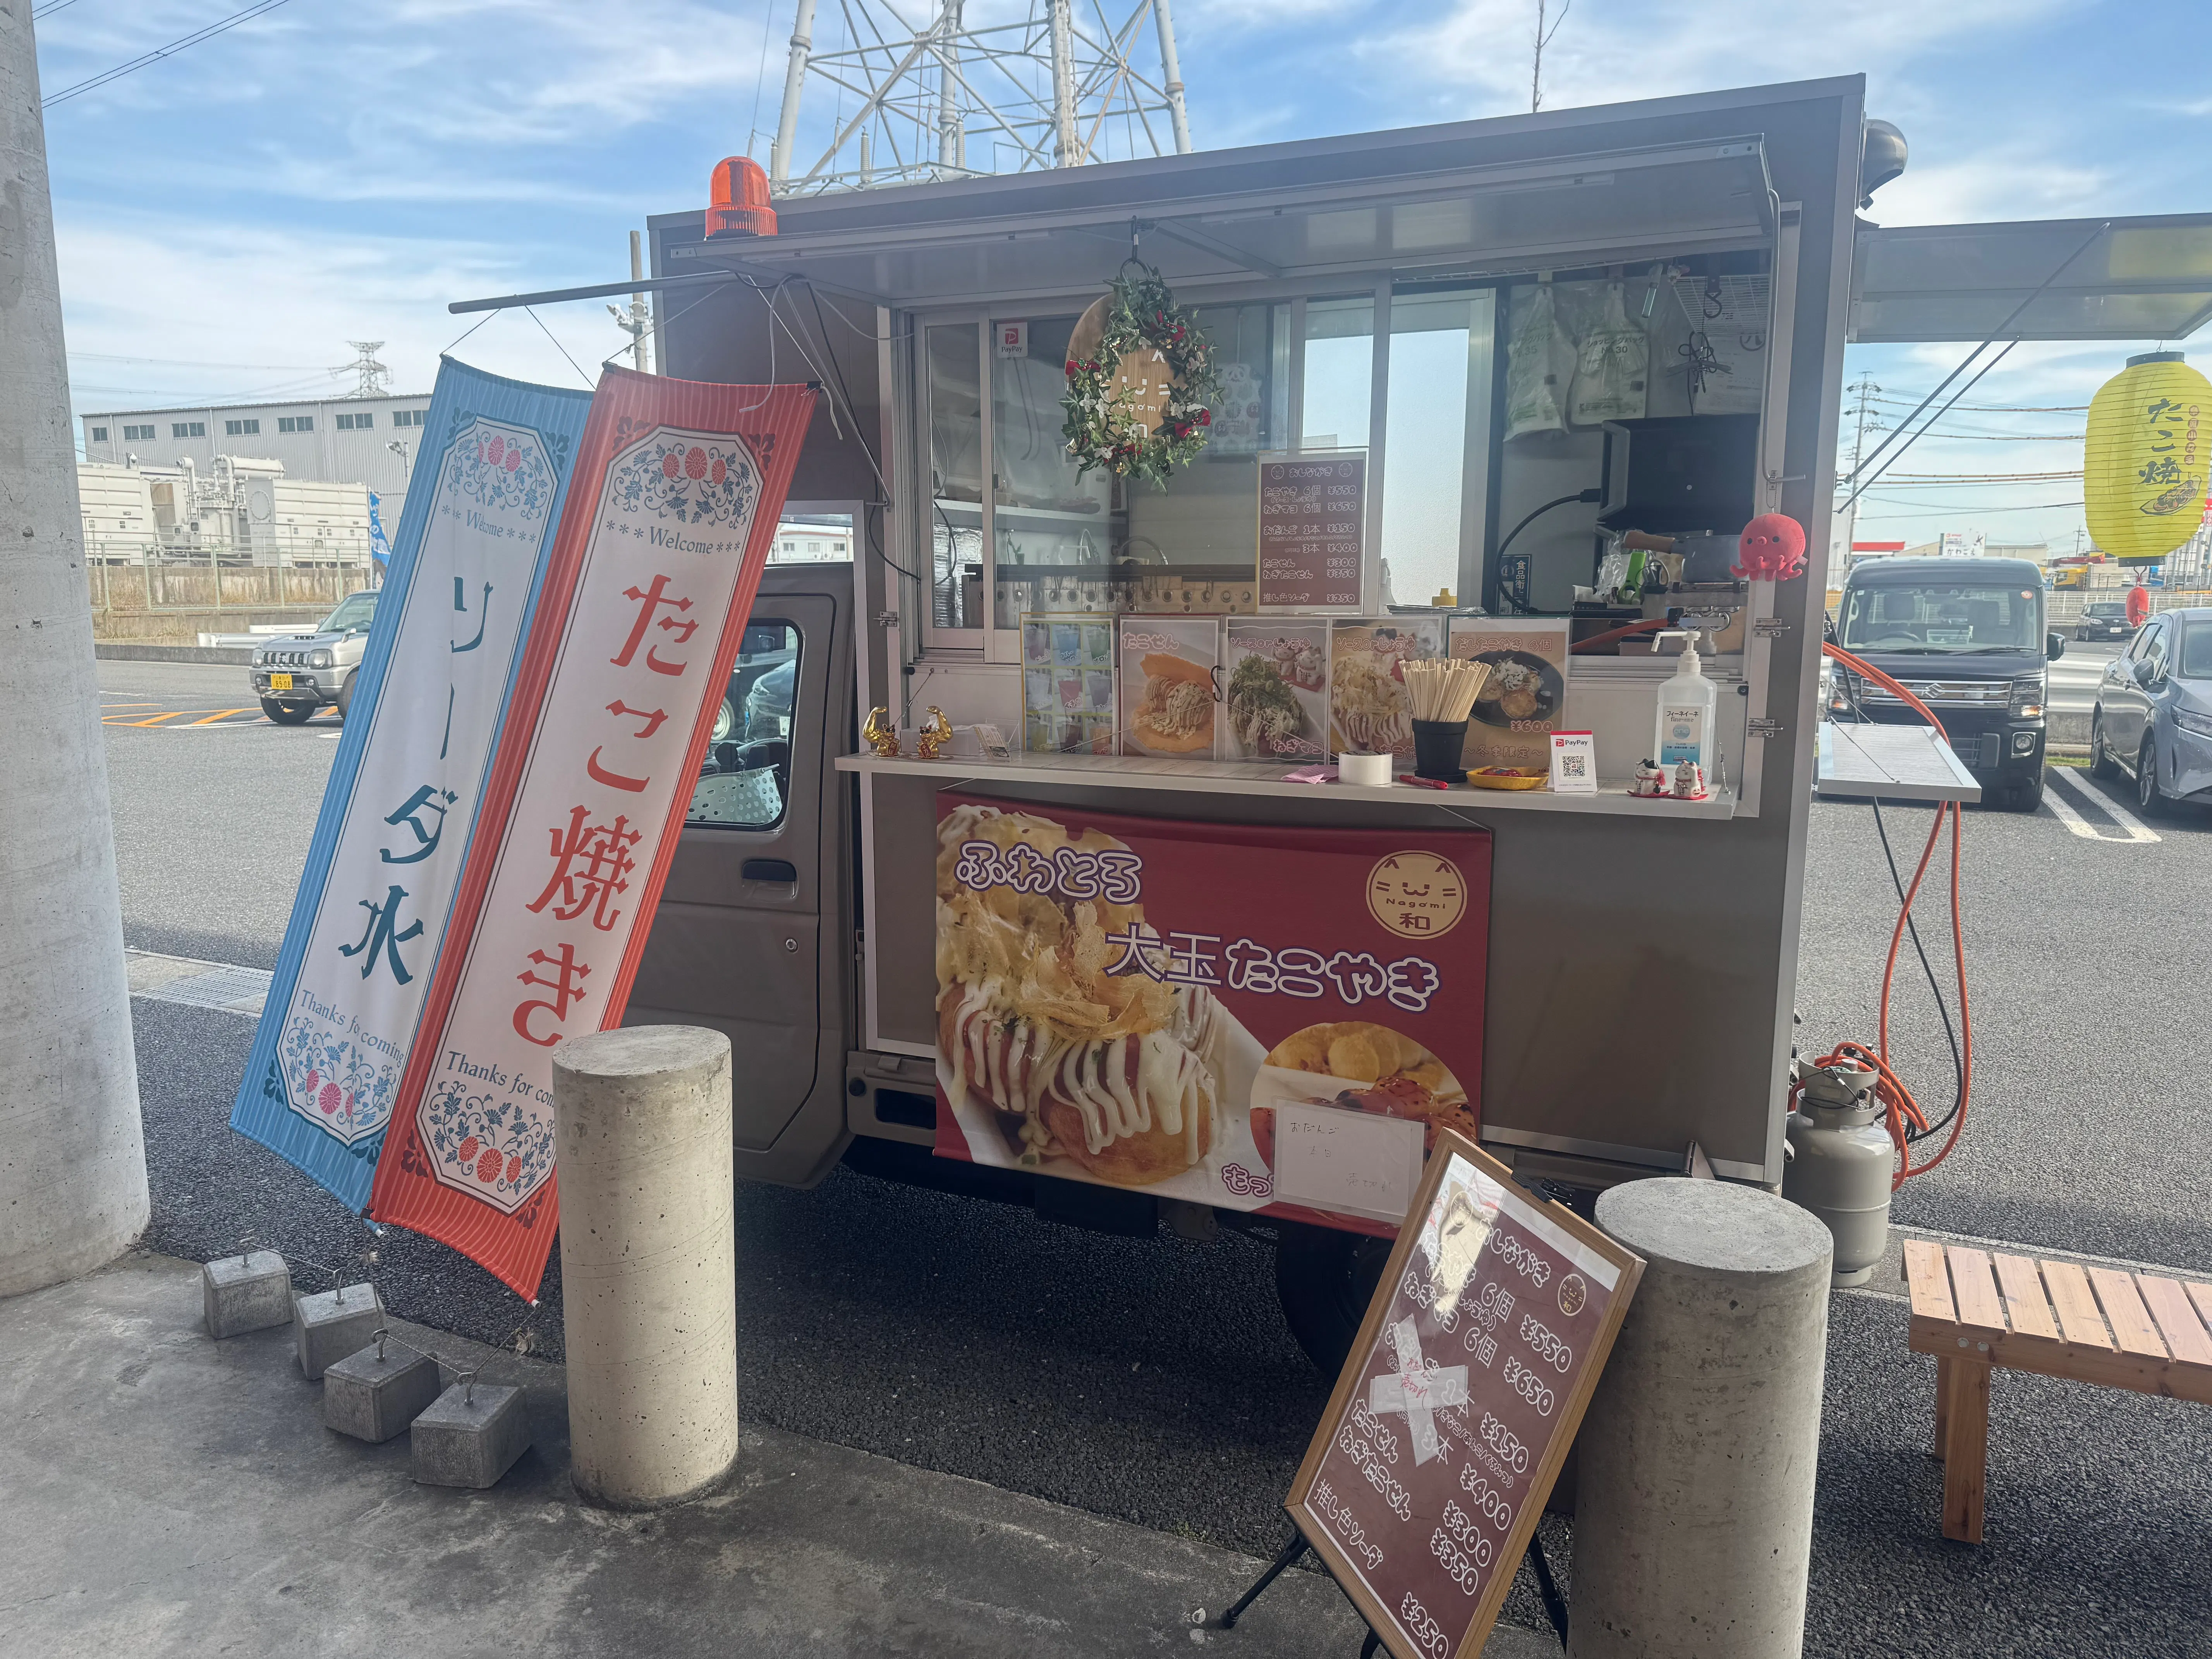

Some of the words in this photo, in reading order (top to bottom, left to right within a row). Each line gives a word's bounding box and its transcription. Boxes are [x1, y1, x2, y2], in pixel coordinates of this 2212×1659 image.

[1001, 346, 1023, 354] PayPay
[1113, 403, 1161, 412] agomi
[2138, 398, 2185, 486] たこ焼
[1289, 467, 1333, 477] おしながき
[1264, 486, 1297, 497] たこやき
[1304, 485, 1321, 496] 6個
[1328, 485, 1356, 495] ¥550
[1263, 504, 1298, 514] ねぎマヨ
[1303, 503, 1321, 514] 6個
[1328, 501, 1356, 511] ¥650
[1263, 525, 1297, 535] おだんご
[1303, 524, 1321, 535] 1本
[1327, 523, 1355, 533] ¥150
[650, 526, 713, 555] Welcome
[1302, 543, 1320, 553] 3本
[1327, 543, 1358, 553] ¥400
[1263, 558, 1295, 568] たこせん
[1327, 558, 1356, 567] ¥300
[1262, 570, 1313, 579] ねぎたこせん
[1327, 569, 1356, 578] ¥350
[1263, 592, 1310, 603] 推し色ソーダ
[1327, 594, 1355, 603] ¥250
[1123, 633, 1180, 649] たこせん
[1230, 637, 1312, 649] ソースorしょうゆ
[1337, 636, 1417, 651] ソースorしょうゆ
[1455, 637, 1522, 651] だしたこやき
[1528, 638, 1552, 651] 4個
[1511, 720, 1554, 733] ¥600
[1273, 738, 1323, 754] ねぎマヨ
[1380, 744, 1417, 759] たこや
[512, 574, 701, 1047] たこ焼き
[955, 840, 1143, 904] ふわとろ
[1386, 898, 1446, 909] Nagomi
[1399, 912, 1430, 930] 和
[1103, 922, 1440, 1012] 大玉たこやき
[300, 989, 345, 1025] Thanks
[361, 1032, 404, 1068] coming
[446, 1051, 507, 1086] Thanks
[508, 1073, 534, 1096] for
[536, 1089, 554, 1108] com
[1290, 1122, 1340, 1135] おだんご
[1221, 1163, 1274, 1198] もっ
[1475, 1217, 1551, 1288] おしながき
[1481, 1282, 1515, 1323] 6個
[1520, 1314, 1572, 1373] ¥550
[1404, 1272, 1460, 1334] ねぎマヨ
[1464, 1327, 1498, 1369] 6個
[1503, 1356, 1554, 1417] ¥650
[1400, 1372, 1428, 1411] 売切れ
[1480, 1412, 1529, 1473] ¥150
[1352, 1398, 1398, 1463] たこせん
[1443, 1499, 1492, 1567] ¥300
[1460, 1463, 1511, 1530] ¥400
[1340, 1425, 1411, 1521] ねぎたこせん
[1431, 1528, 1478, 1595] ¥350
[1314, 1479, 1383, 1570] 推し色ソーダ
[1401, 1592, 1448, 1659] ¥250
